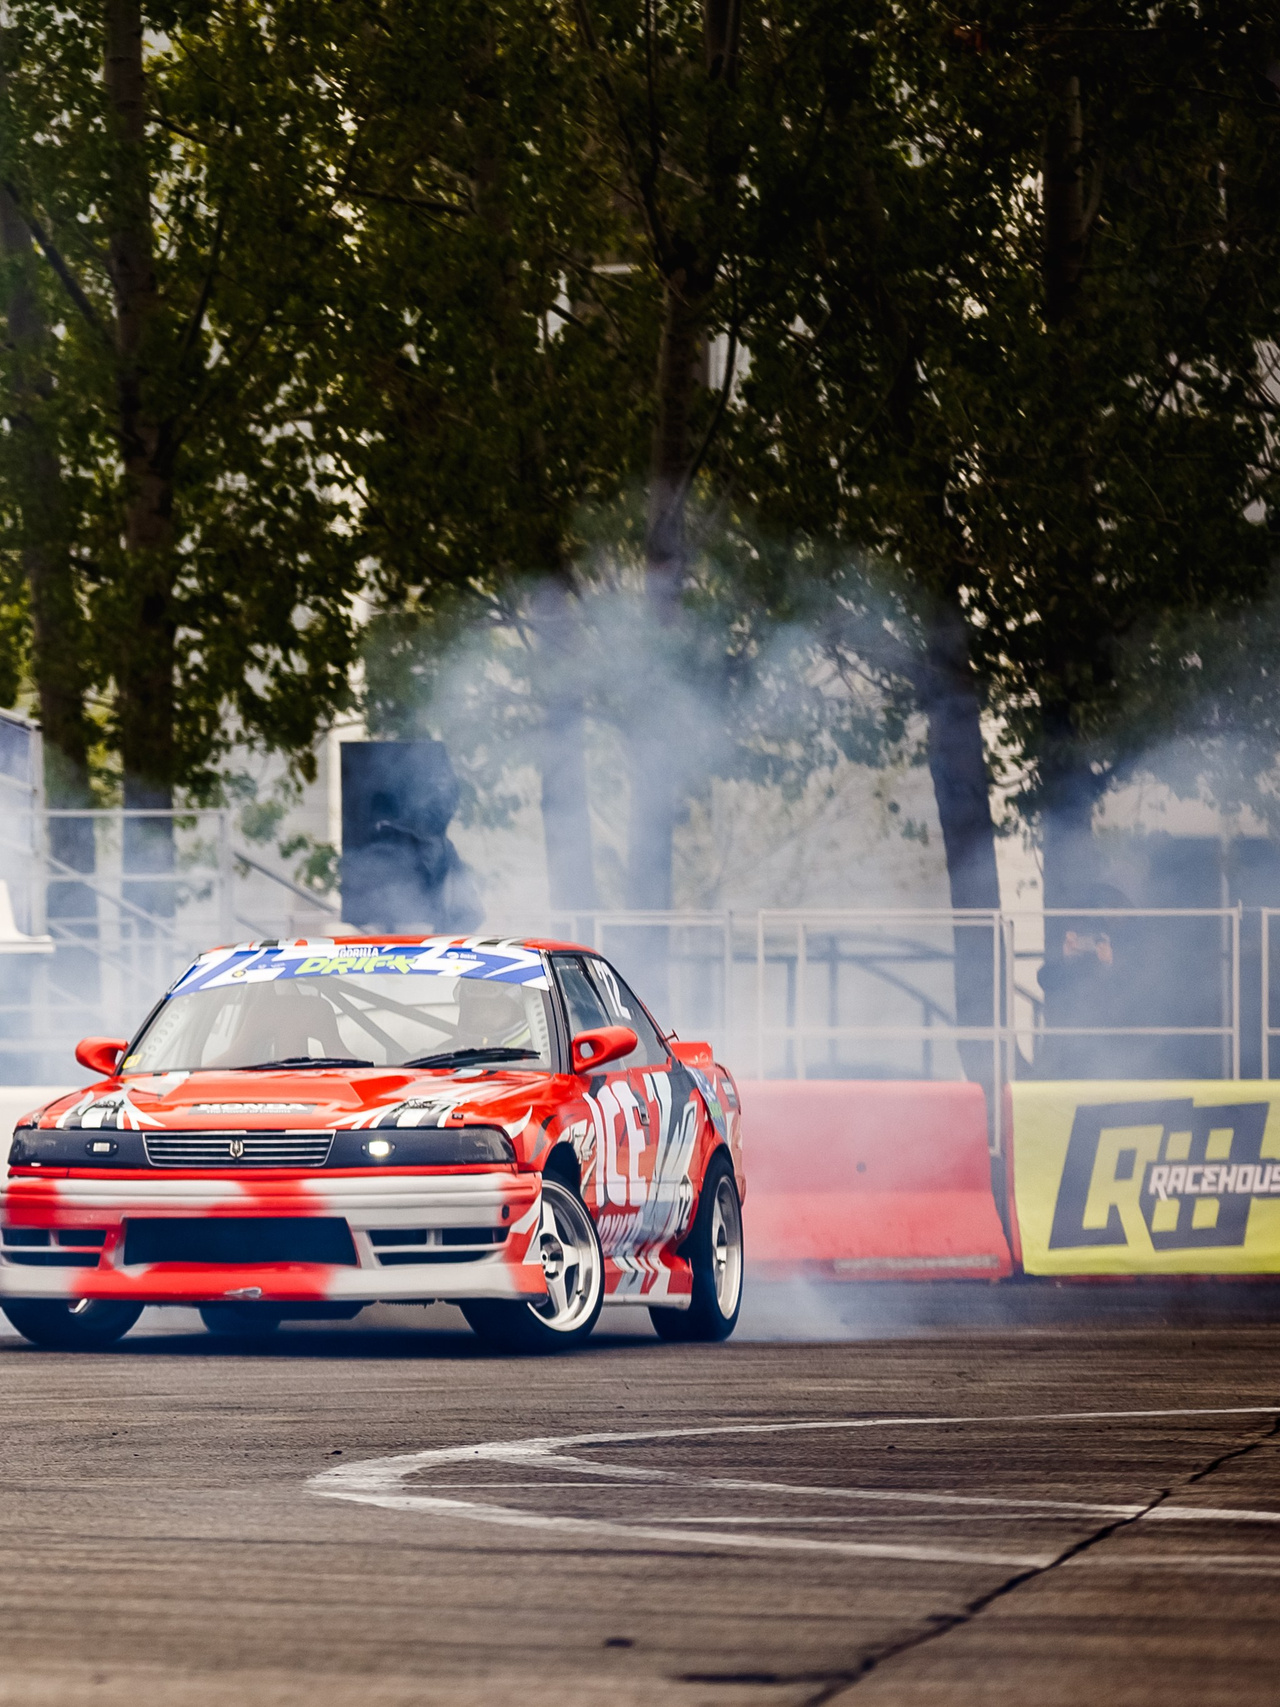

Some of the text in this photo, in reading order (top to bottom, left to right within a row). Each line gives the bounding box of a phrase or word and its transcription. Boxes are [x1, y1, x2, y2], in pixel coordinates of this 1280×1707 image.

[338, 947, 379, 958] GORILLA
[591, 959, 631, 1020] 72
[197, 1103, 308, 1111] HONDA
[582, 1080, 647, 1208] ICE
